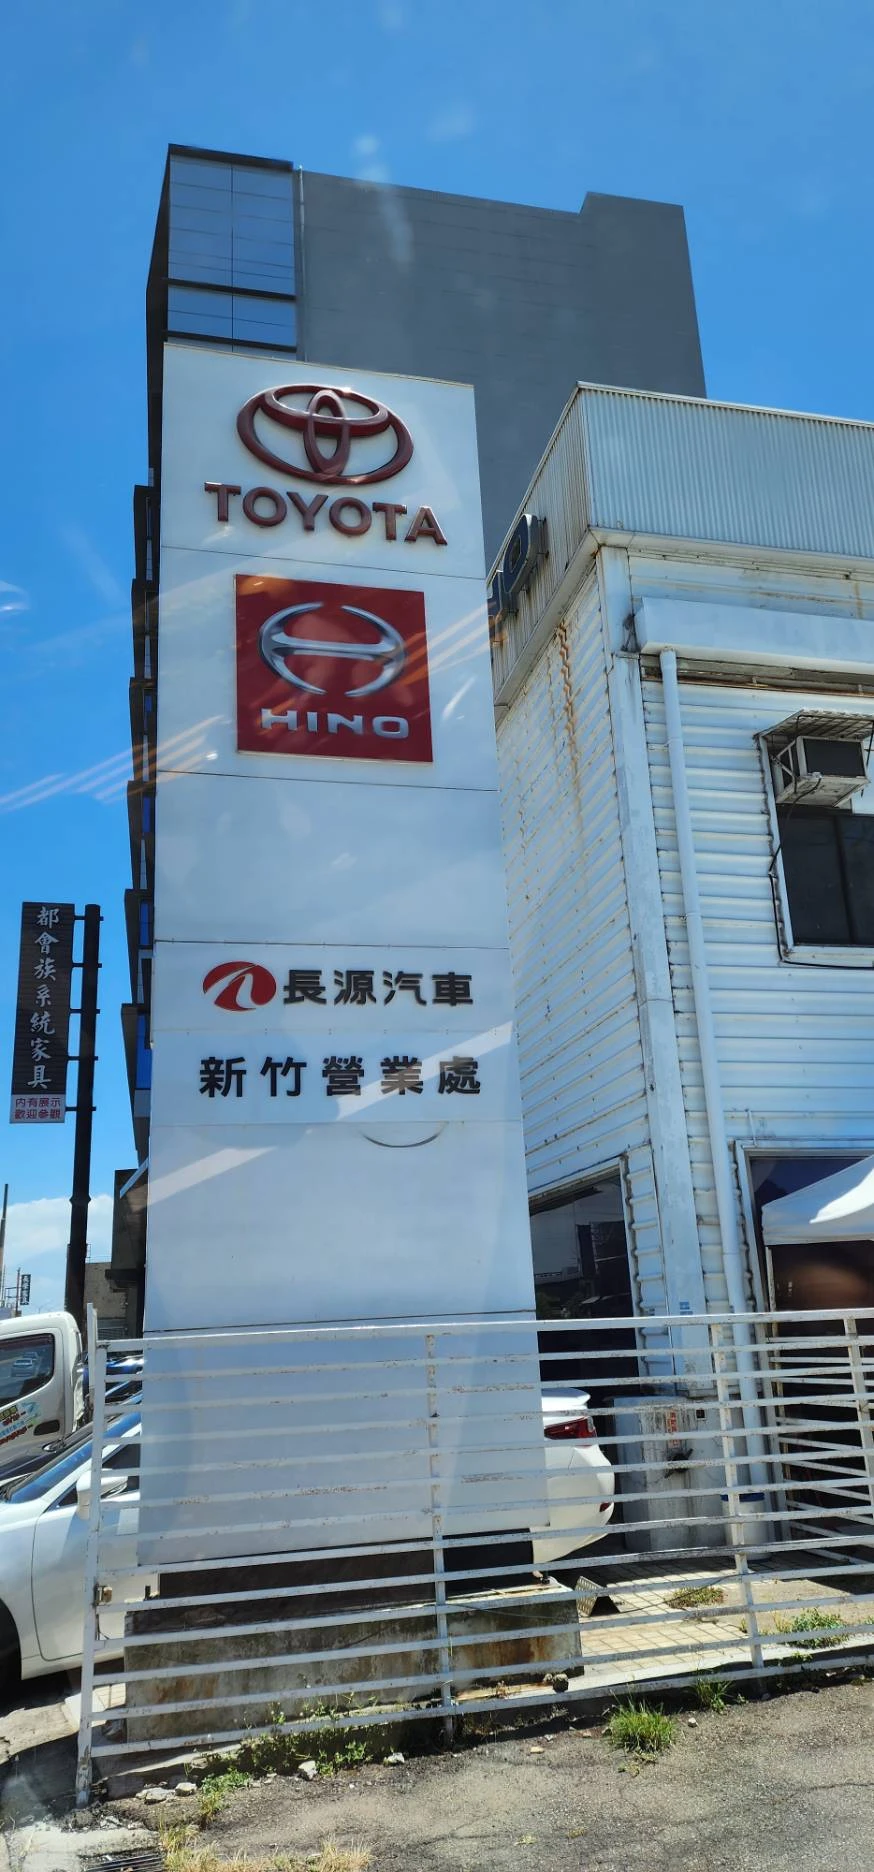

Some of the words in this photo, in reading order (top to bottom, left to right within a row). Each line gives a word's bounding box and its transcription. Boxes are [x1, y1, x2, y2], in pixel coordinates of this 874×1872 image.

[204, 481, 447, 546] TOYOTA
[261, 708, 409, 739] HINO
[28, 906, 60, 1089] 都會族系統家具
[283, 970, 473, 1006] 長源汽車
[200, 1055, 480, 1098] 新竹營業處
